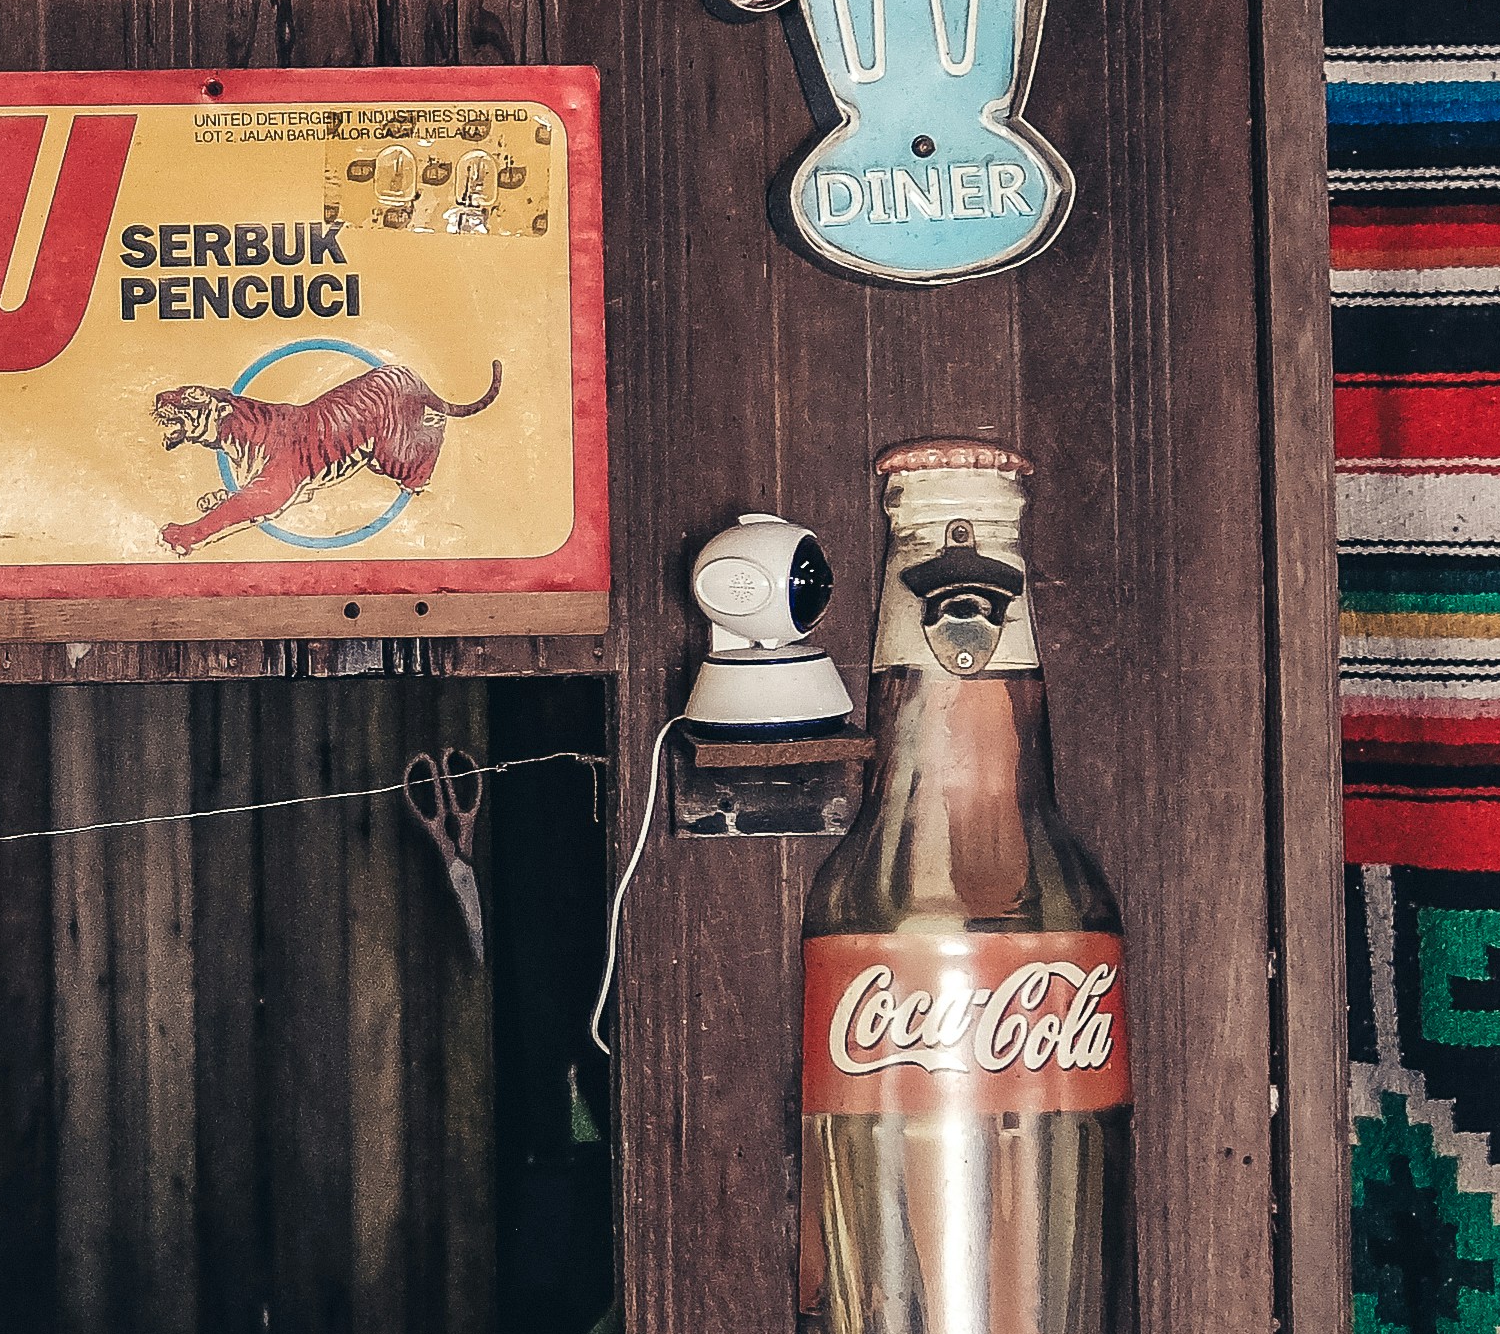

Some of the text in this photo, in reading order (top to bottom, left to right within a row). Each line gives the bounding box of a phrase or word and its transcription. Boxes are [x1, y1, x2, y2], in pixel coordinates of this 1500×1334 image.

[194, 112, 253, 127] UNITED
[256, 110, 353, 126] DETERGENT
[357, 109, 456, 124] INDUSTRIES
[194, 130, 222, 144] LOT
[239, 129, 284, 142] JALAN
[332, 127, 371, 141] ALOR
[813, 161, 1036, 227] DINER
[118, 221, 348, 269] SERBUK
[119, 273, 362, 322] PENCUCI
[828, 960, 1118, 1076] Coca-Cola
